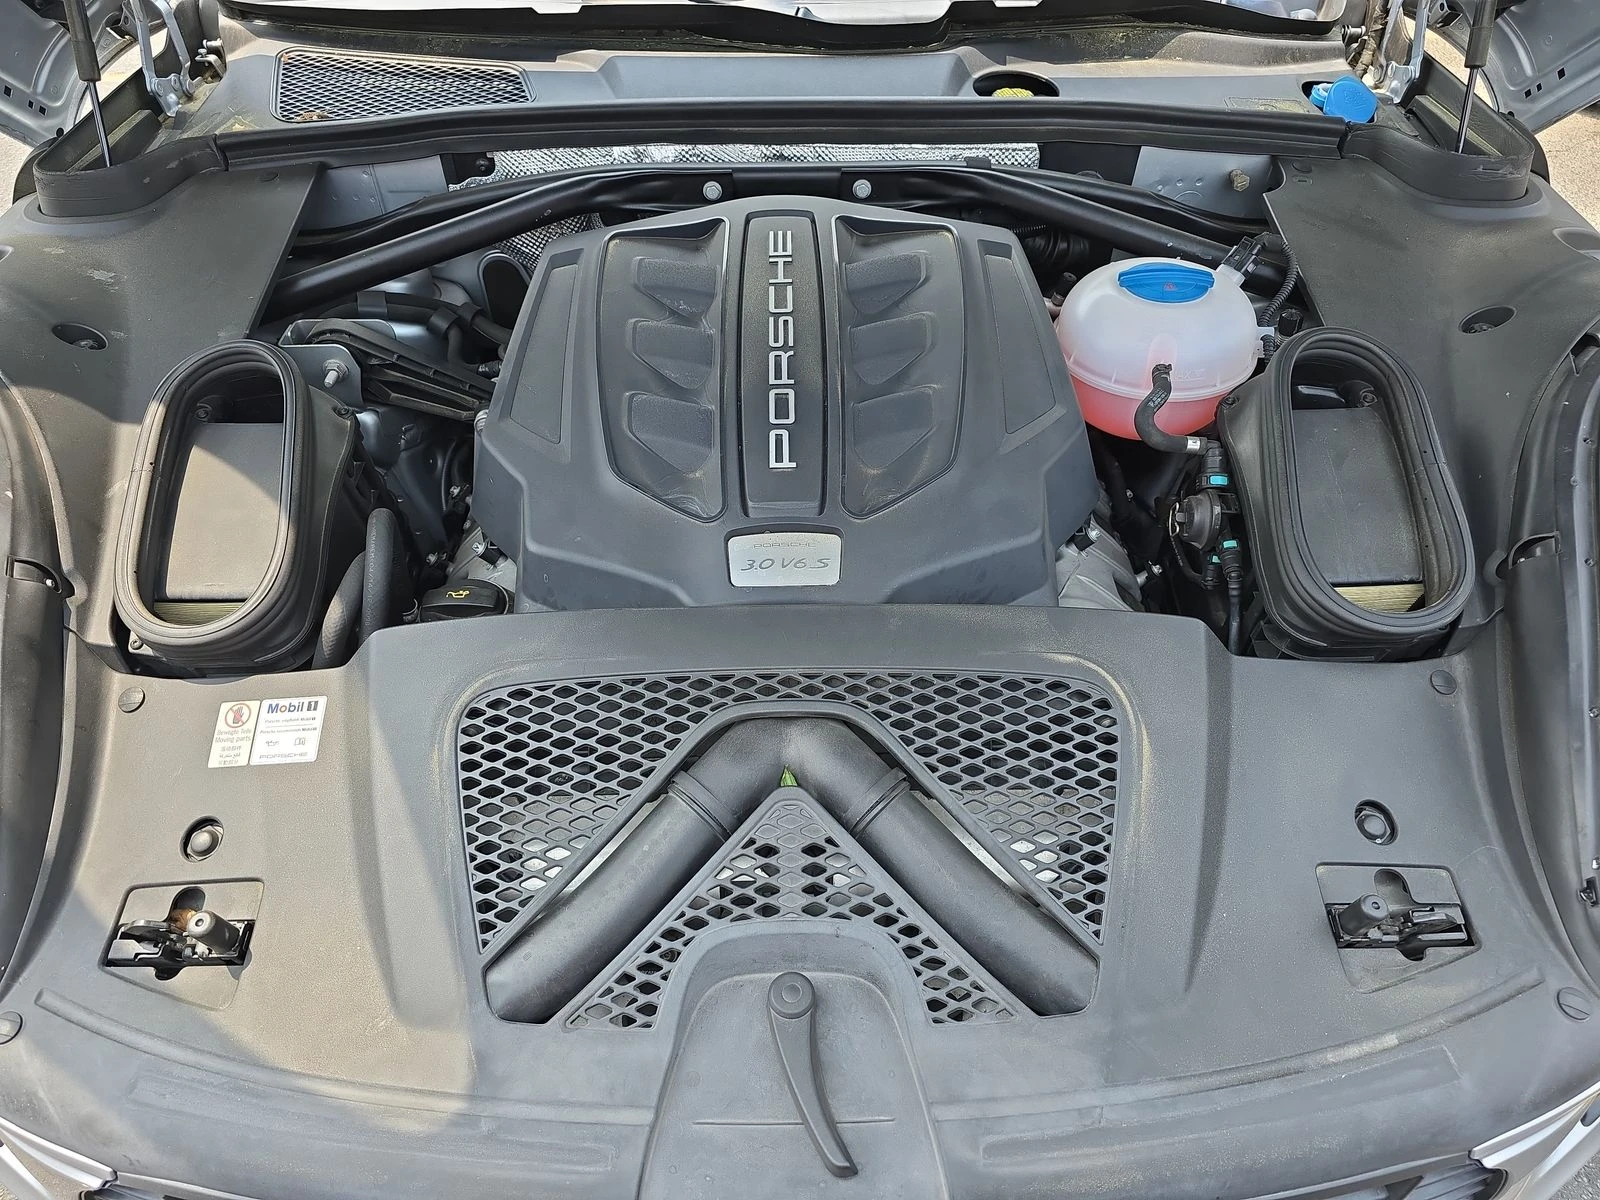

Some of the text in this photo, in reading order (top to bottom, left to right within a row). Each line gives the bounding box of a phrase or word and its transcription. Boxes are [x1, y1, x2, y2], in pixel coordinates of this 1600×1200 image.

[768, 230, 797, 469] PORSCHE
[740, 557, 832, 571] 3.0 V6 S
[267, 700, 319, 714] Mobil 1
